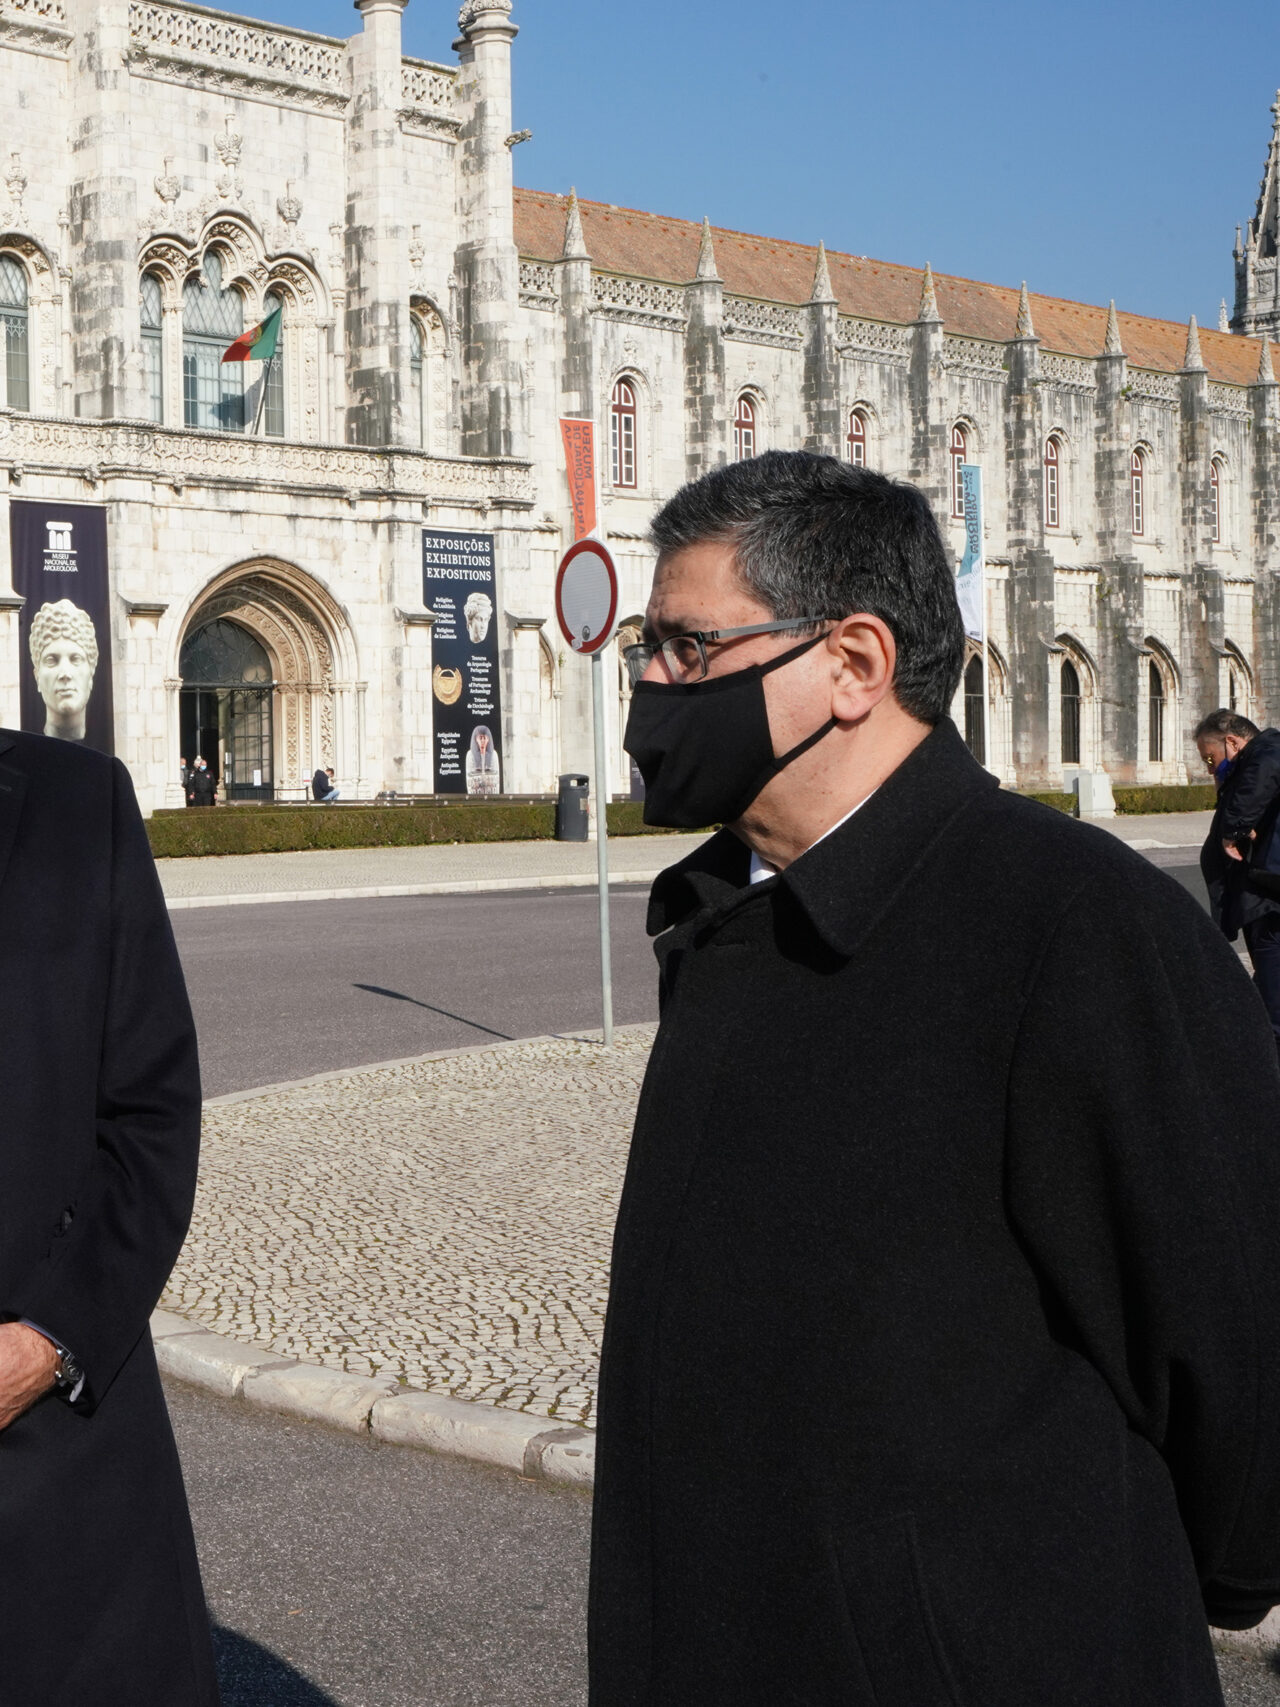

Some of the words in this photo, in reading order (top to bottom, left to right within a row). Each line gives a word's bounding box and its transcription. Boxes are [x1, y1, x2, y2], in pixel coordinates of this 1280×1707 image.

[425, 538, 490, 553] EXPOSIÇÕES
[426, 552, 491, 566] EXHIBITIONS
[426, 568, 491, 581] EXPOSITIONS
